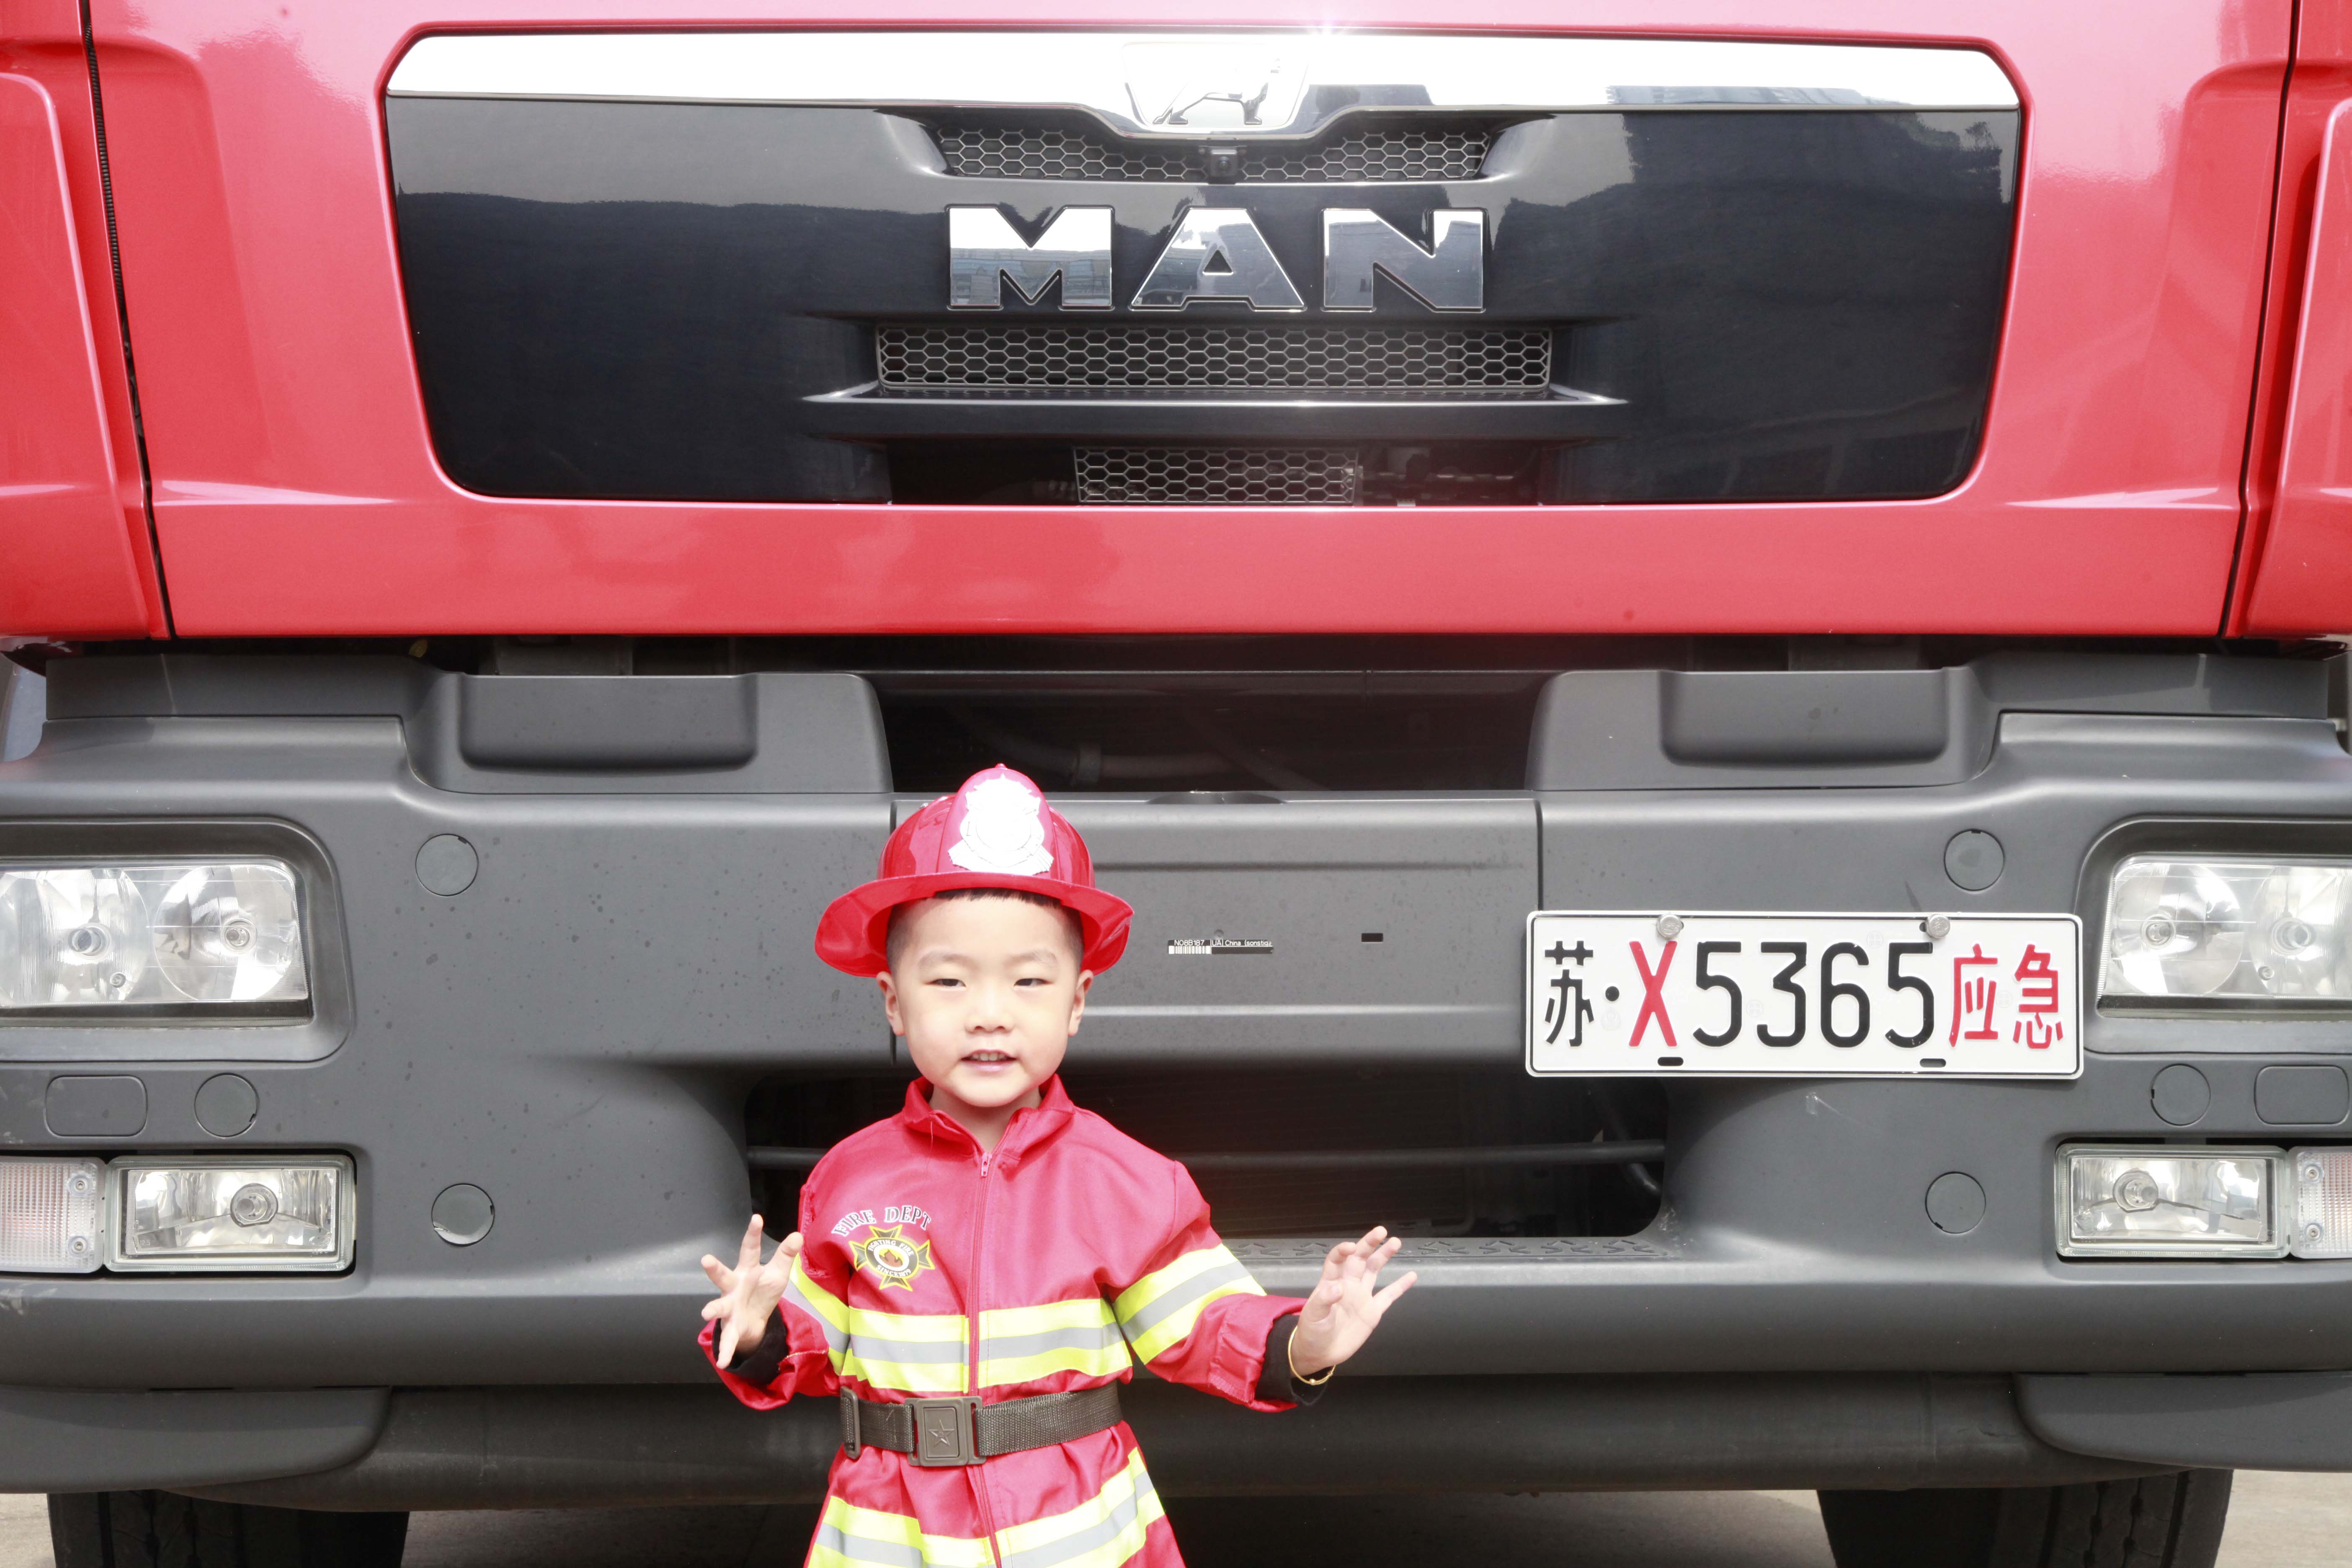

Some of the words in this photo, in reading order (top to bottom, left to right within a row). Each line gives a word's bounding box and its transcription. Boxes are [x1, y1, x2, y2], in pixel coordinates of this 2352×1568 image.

[947, 206, 1485, 312] MAN
[831, 1210, 877, 1237] FIRE
[884, 1205, 931, 1230] DEPT
[868, 1240, 896, 1251] FIGHTING
[899, 1243, 914, 1256] FIRE
